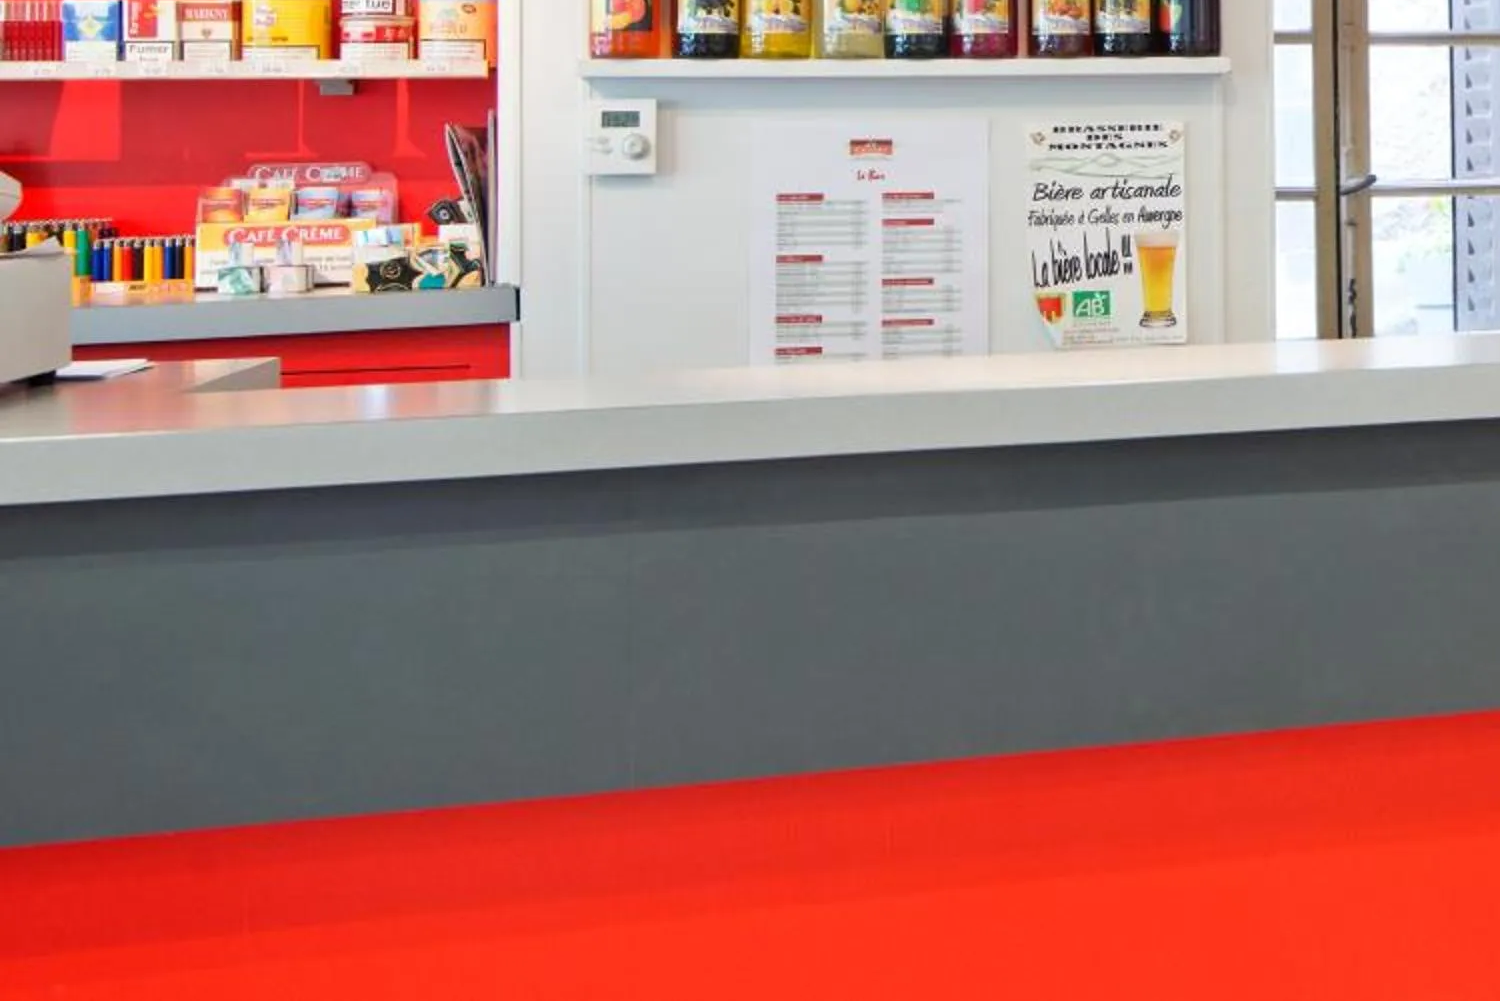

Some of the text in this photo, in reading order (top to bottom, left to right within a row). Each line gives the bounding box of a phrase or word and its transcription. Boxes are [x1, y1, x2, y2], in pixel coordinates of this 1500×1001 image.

[1053, 124, 1162, 134] BRASSERIE
[1087, 133, 1123, 141] DES
[1049, 141, 1168, 151] MONTAGNES
[1032, 173, 1182, 201] Bière artisanale
[1138, 206, 1184, 230] Auvergne
[1031, 249, 1050, 288] La
[1050, 238, 1082, 286] bière
[1083, 226, 1120, 280] locale
[1075, 296, 1106, 317] AB
